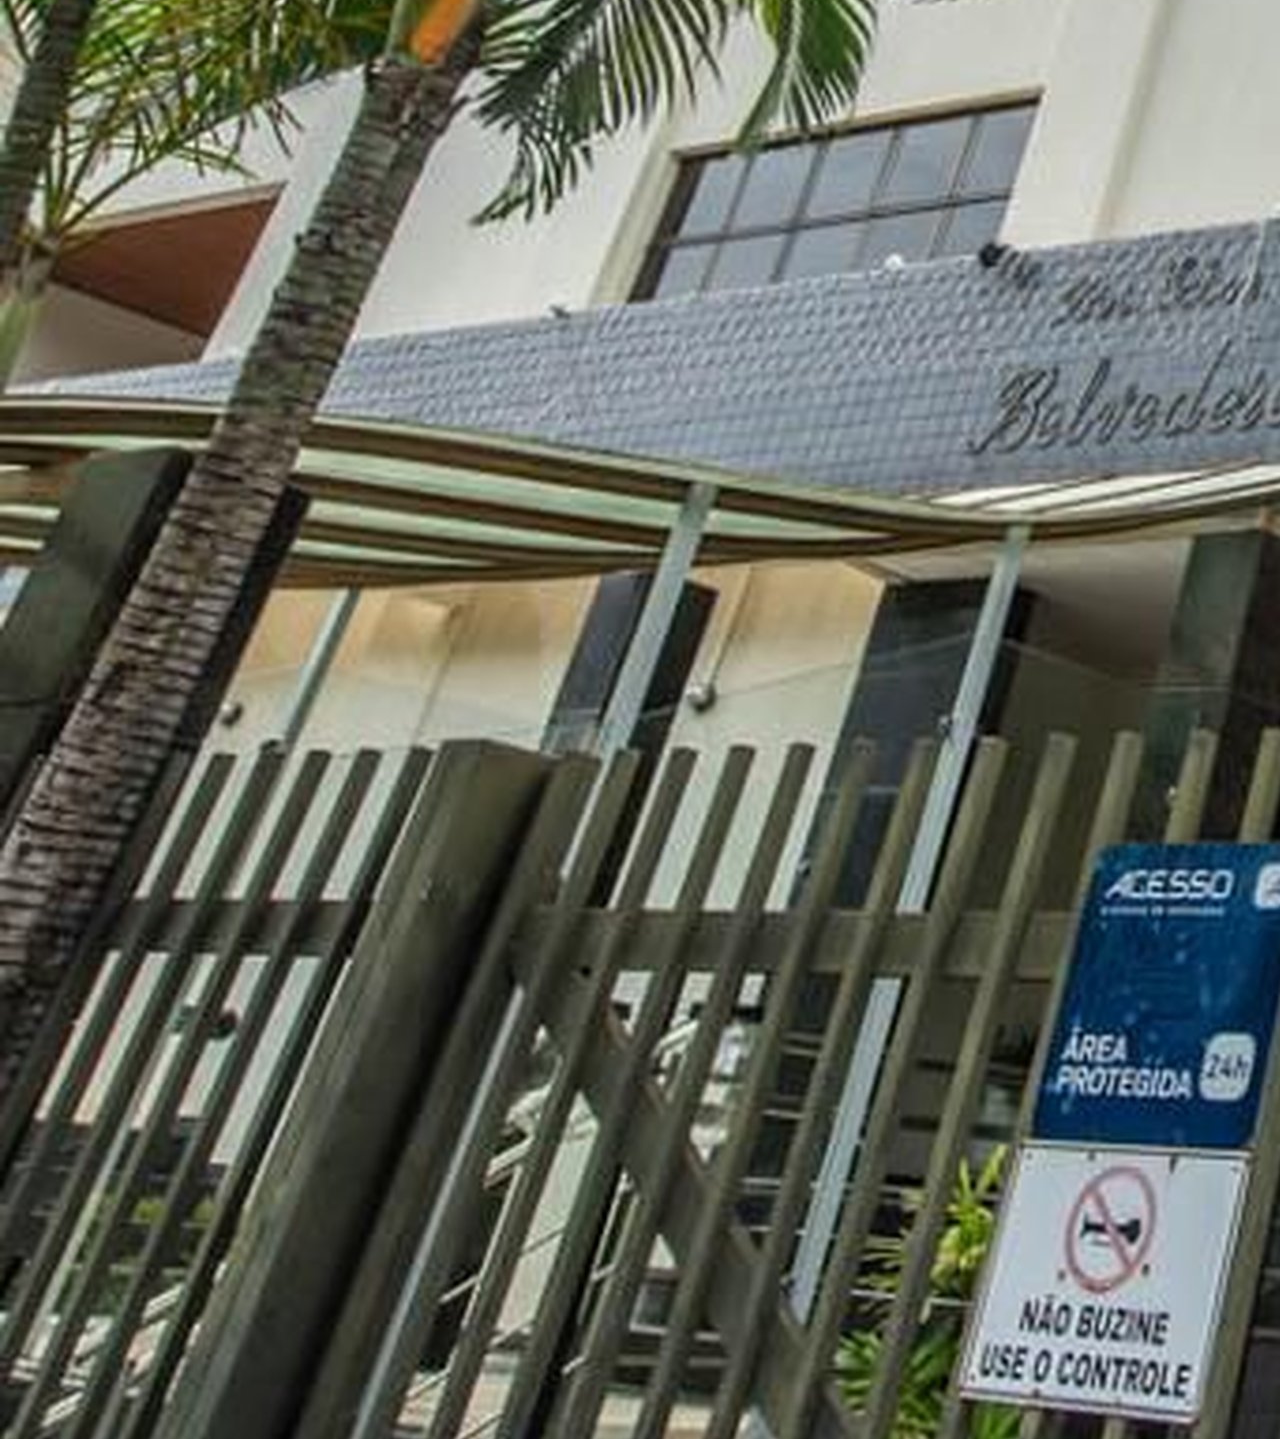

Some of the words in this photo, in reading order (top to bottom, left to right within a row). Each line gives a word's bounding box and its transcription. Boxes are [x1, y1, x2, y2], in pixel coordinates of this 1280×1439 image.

[1105, 869, 1234, 900] ACESSO
[1060, 1026, 1128, 1062] ÁREA
[1055, 1064, 1193, 1100] PROTEGIDA
[1204, 1051, 1250, 1081] 24h
[1018, 1293, 1072, 1336] NÃO
[1075, 1304, 1171, 1346] BUZINE
[980, 1343, 1028, 1380] USE
[1033, 1349, 1051, 1382] O
[1056, 1352, 1192, 1397] CONTROLE
